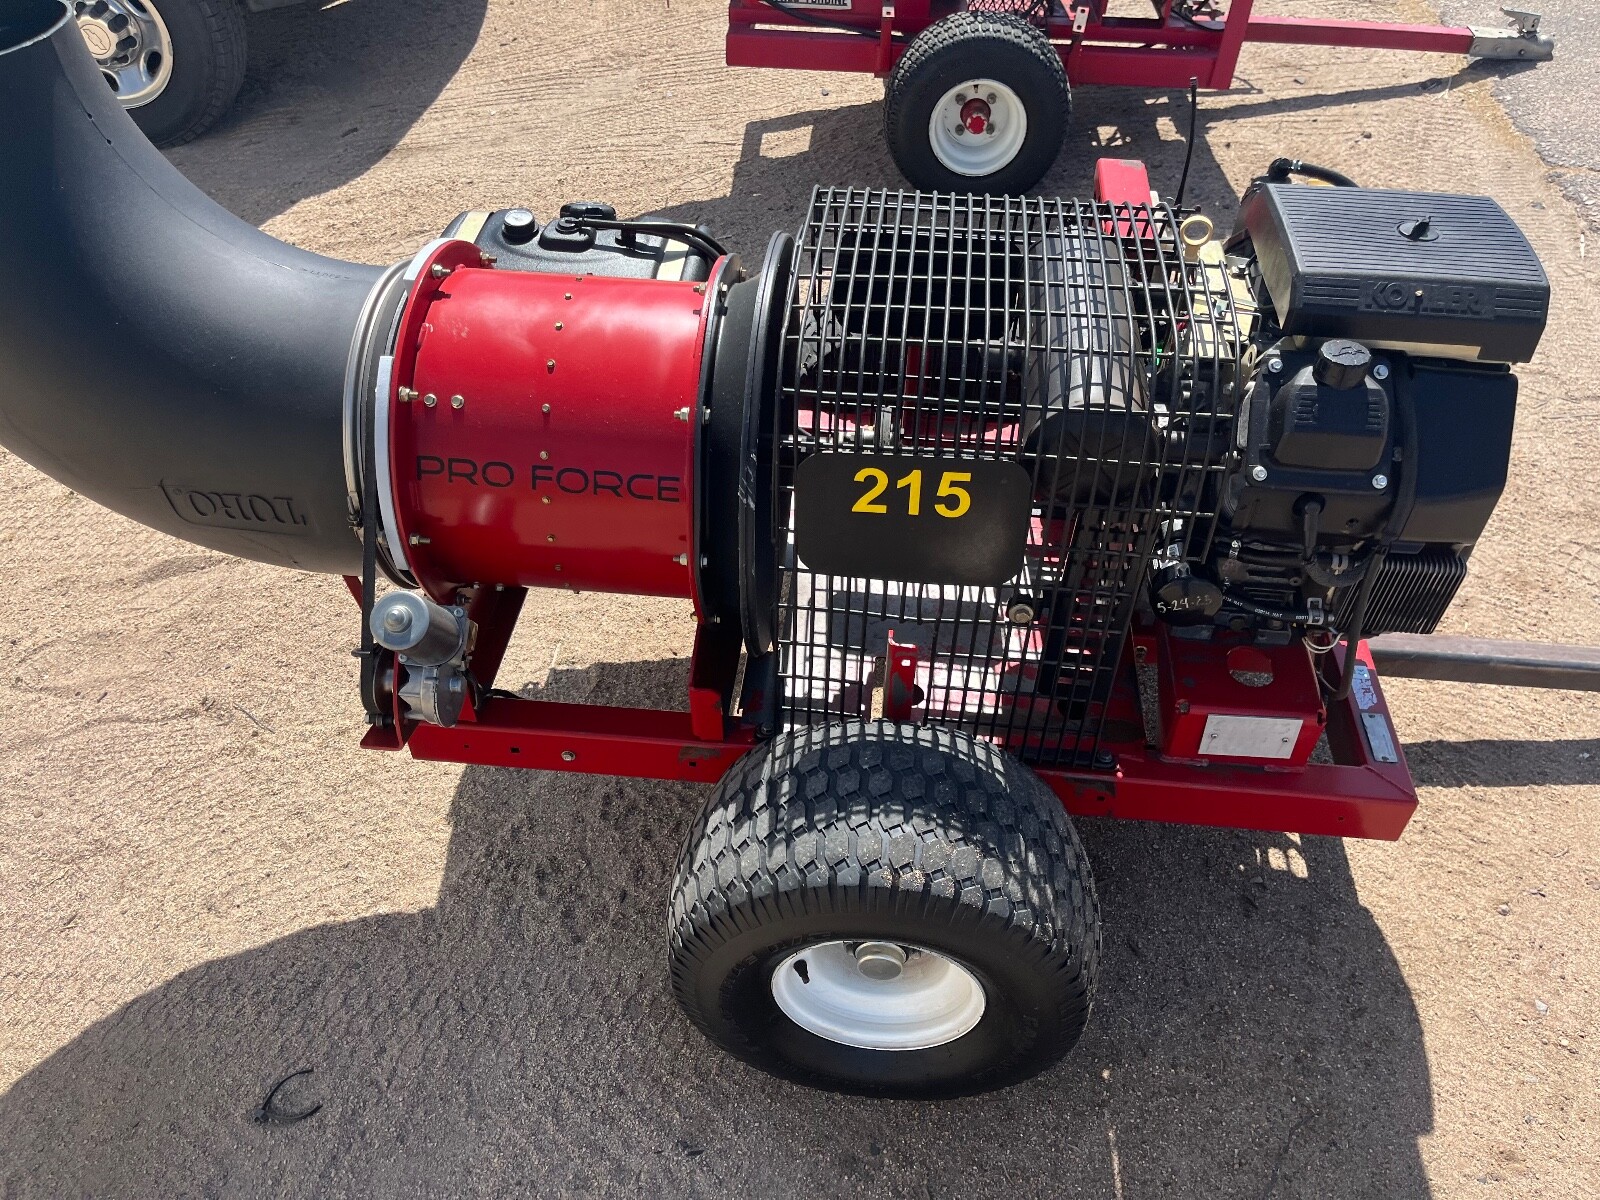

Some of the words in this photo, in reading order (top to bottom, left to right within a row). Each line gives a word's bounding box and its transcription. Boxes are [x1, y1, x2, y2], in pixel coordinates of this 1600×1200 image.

[1363, 280, 1483, 316] KOHLER
[416, 455, 515, 487] PRO
[531, 464, 680, 503] FORCE
[851, 467, 972, 518] 215
[187, 490, 307, 526] TORO
